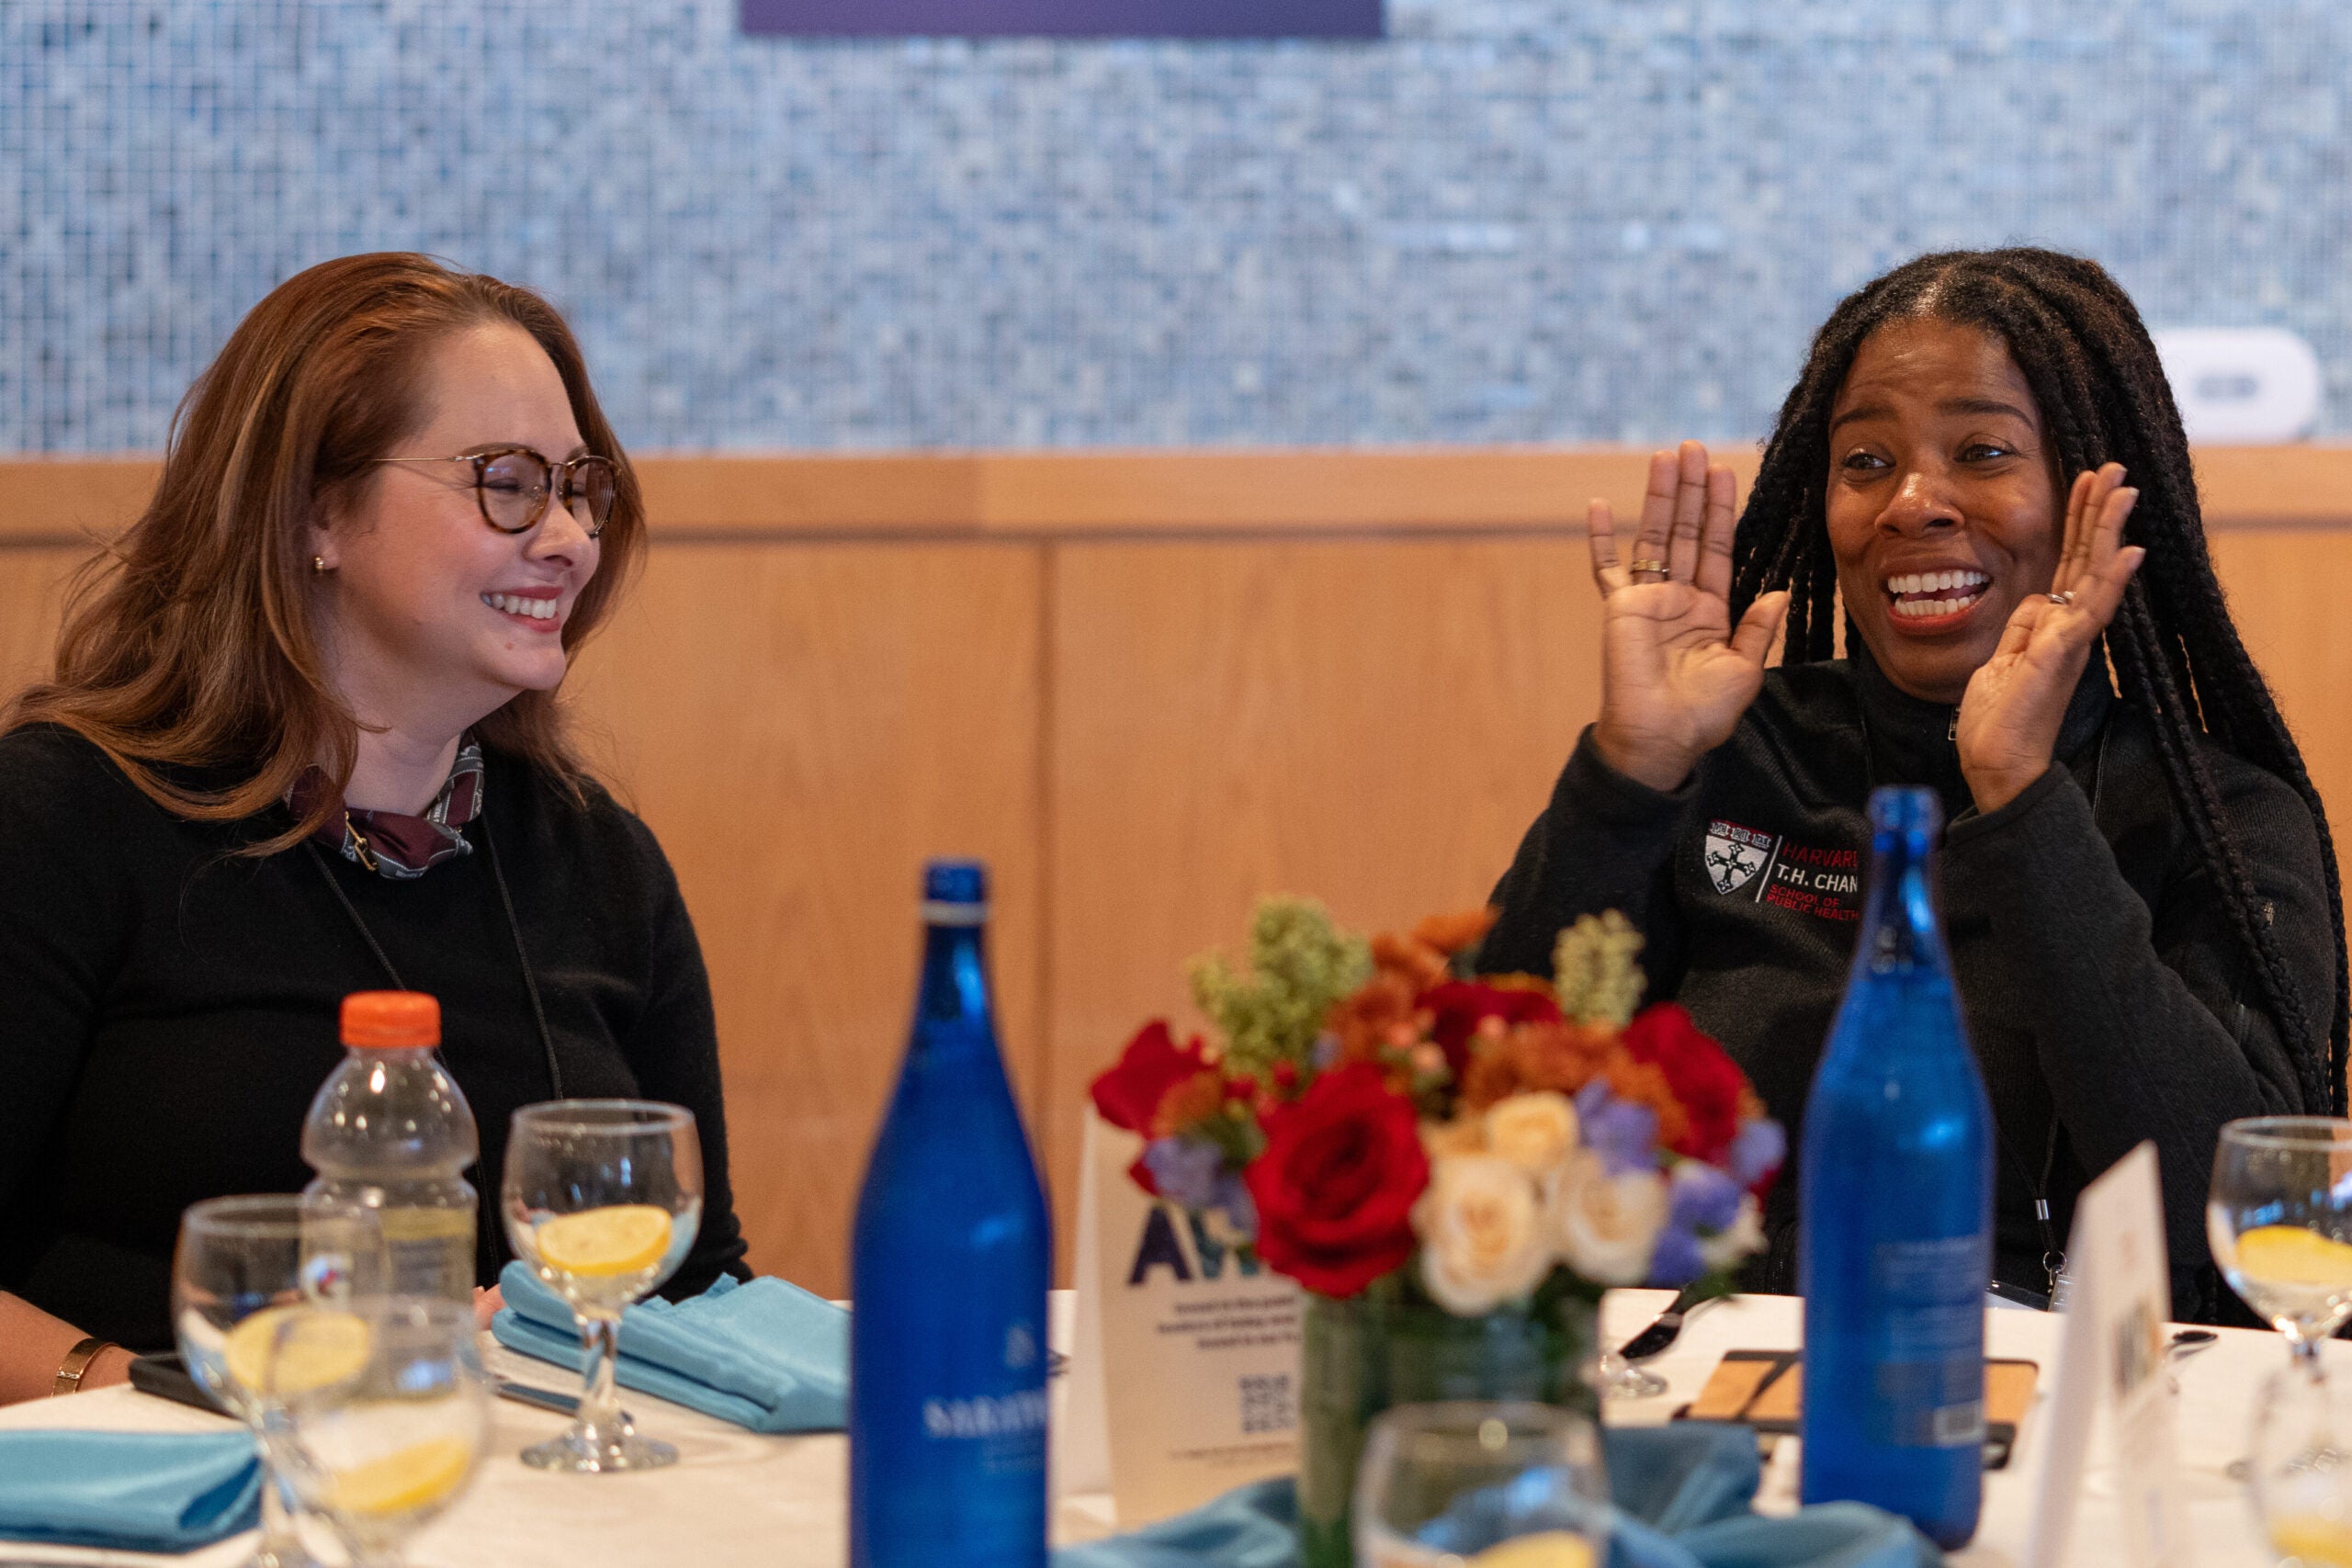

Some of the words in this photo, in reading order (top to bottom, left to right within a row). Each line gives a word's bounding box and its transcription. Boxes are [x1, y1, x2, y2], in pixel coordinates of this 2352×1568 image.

[1778, 863, 1809, 886] T.H.
[1815, 874, 1858, 893] CHAN
[1766, 894, 1812, 913] PUBLIC
[1814, 907, 1860, 920] HEALTH
[1770, 884, 1818, 905] SCHOOL
[1823, 897, 1840, 908] OF
